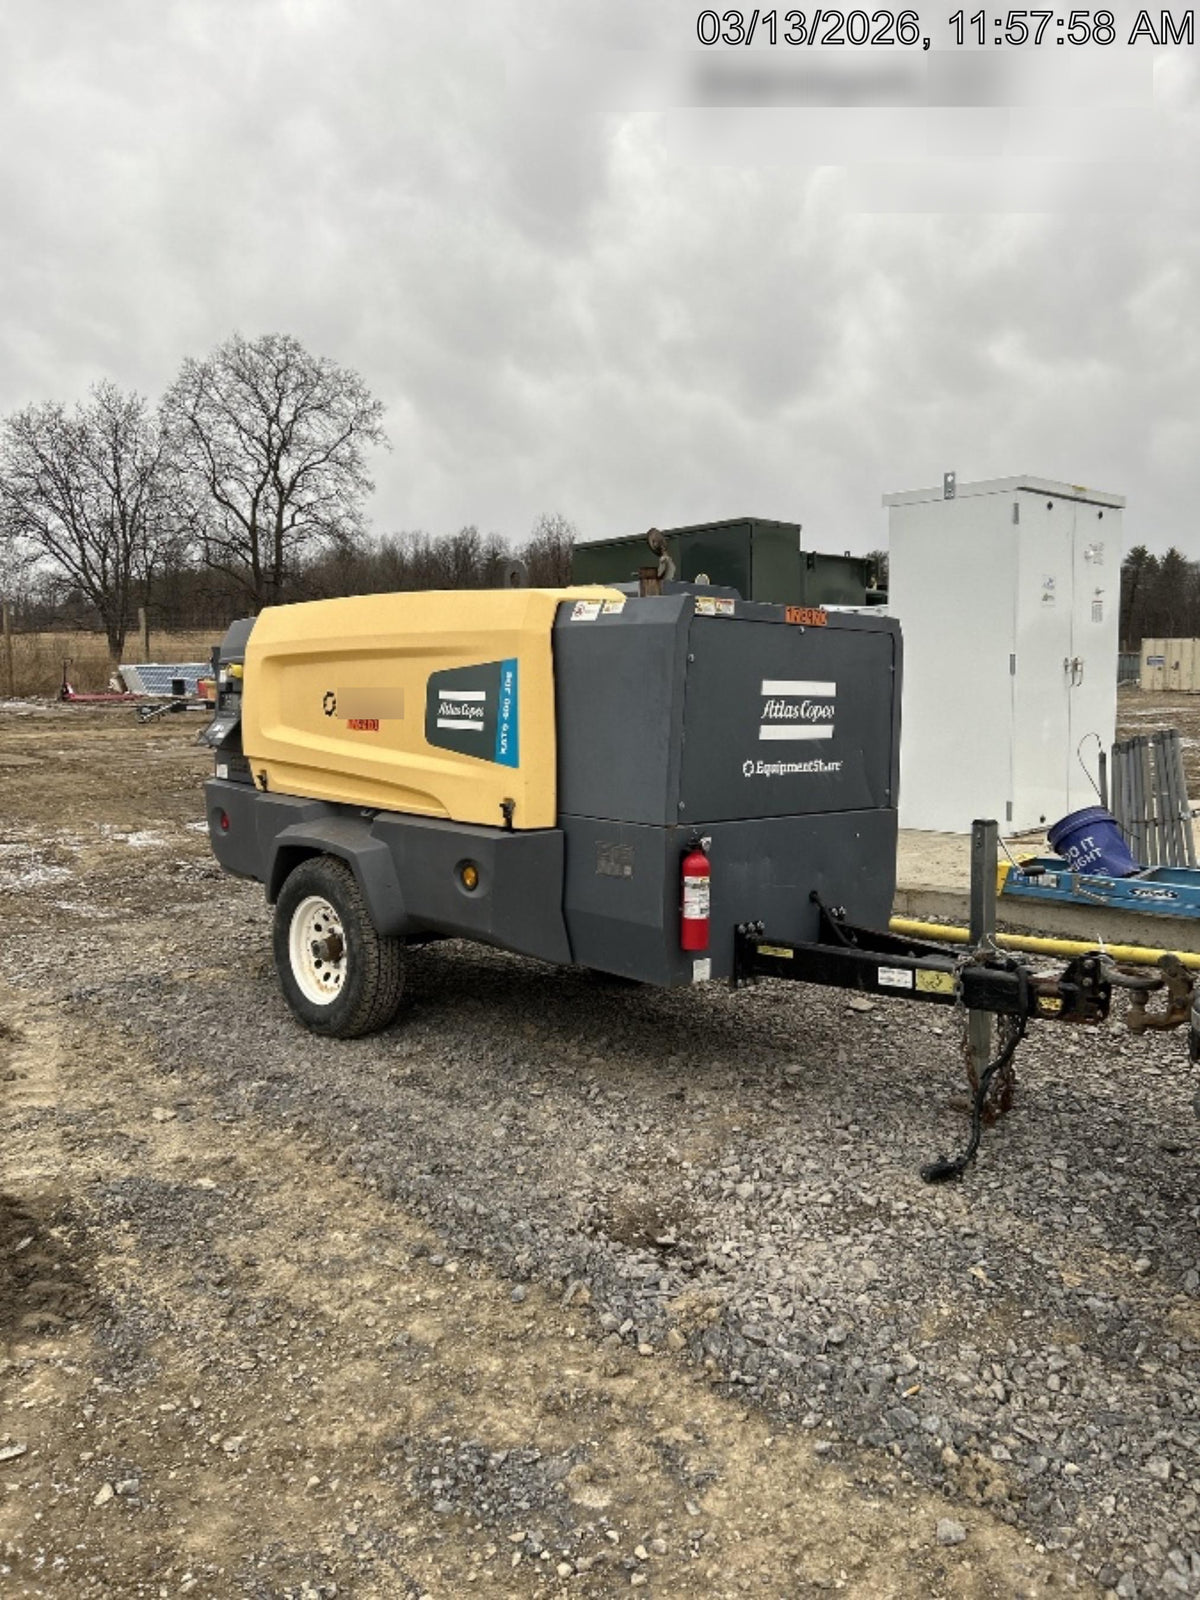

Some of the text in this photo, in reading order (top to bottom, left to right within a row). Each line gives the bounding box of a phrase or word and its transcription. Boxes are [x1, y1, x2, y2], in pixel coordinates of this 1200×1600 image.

[761, 700, 835, 722] Atlas Copco
[1081, 837, 1094, 851] IT
